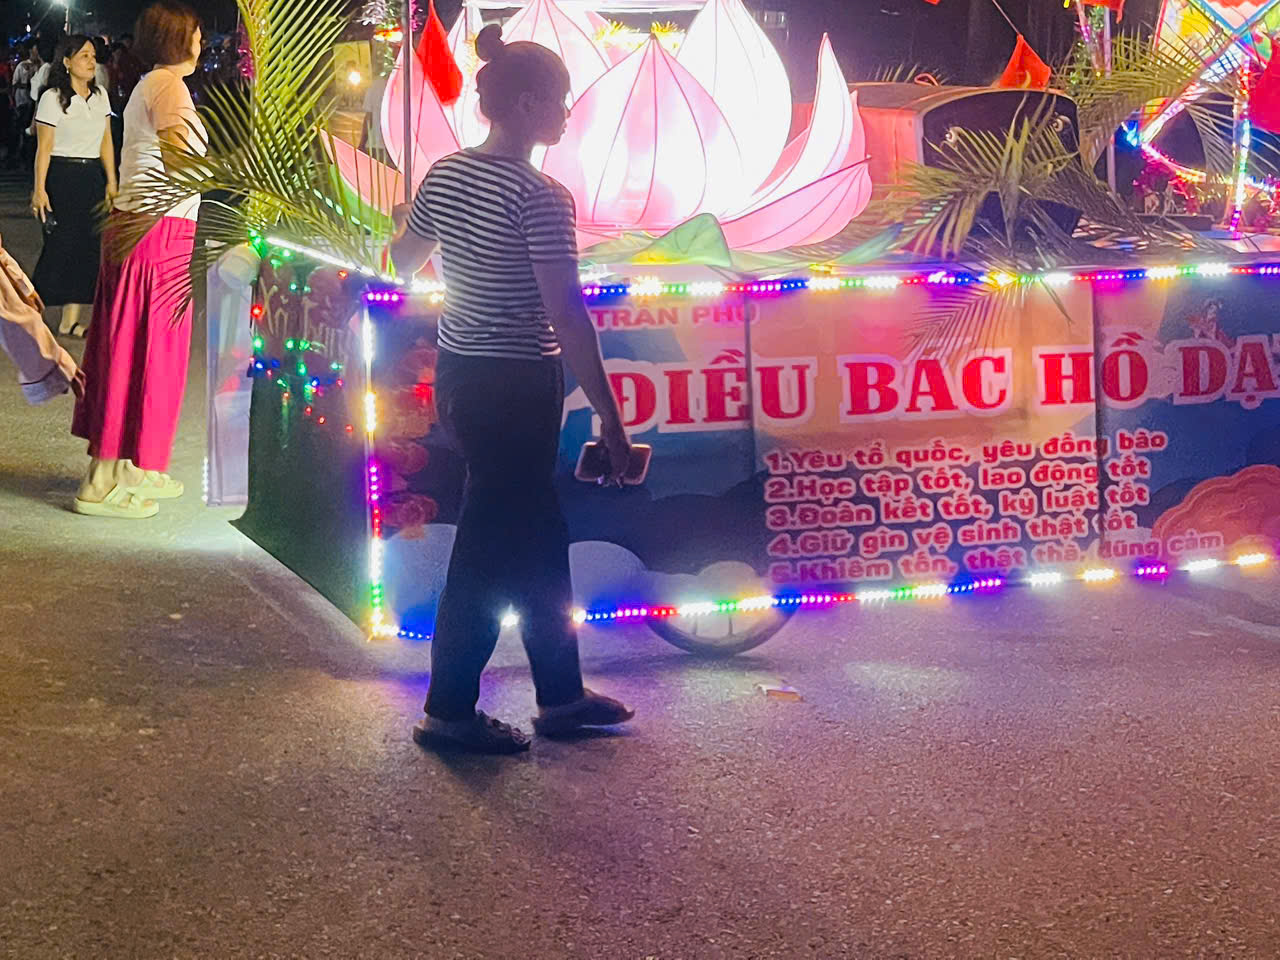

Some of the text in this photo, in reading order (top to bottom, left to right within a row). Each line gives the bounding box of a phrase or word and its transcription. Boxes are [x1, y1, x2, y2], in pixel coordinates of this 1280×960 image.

[608, 348, 810, 427] ĐIỀU
[1039, 331, 1149, 405] HỒ
[1177, 341, 1280, 403] DẠ
[766, 450, 843, 472] 1.Yêu
[983, 441, 1033, 464] yêu
[1044, 432, 1109, 457] đồng
[1120, 430, 1167, 451] bào
[768, 480, 855, 504] 2.Học
[982, 469, 1022, 485] lao
[1032, 463, 1099, 486] động
[1109, 455, 1149, 477] tốt
[883, 494, 931, 521] kết
[1045, 490, 1099, 514] luật
[1108, 481, 1149, 504] tốt
[862, 529, 906, 556] gìn
[915, 525, 951, 551] vệ
[960, 521, 1019, 543] sinh
[1029, 516, 1086, 540] thật
